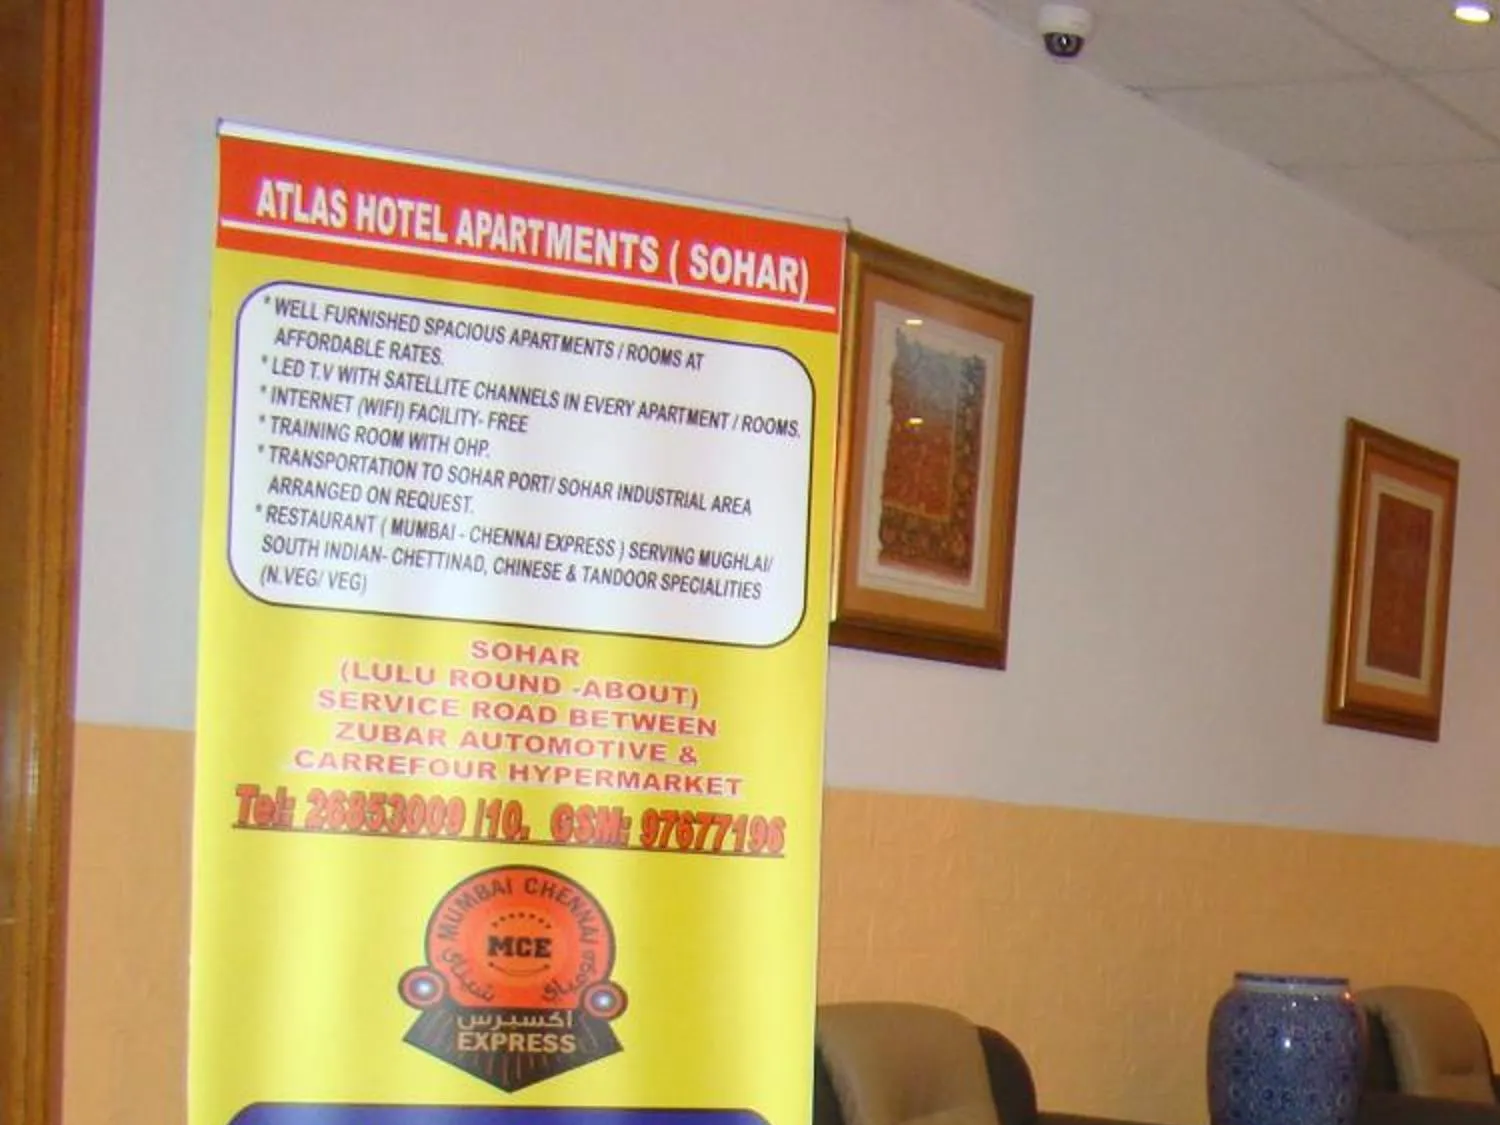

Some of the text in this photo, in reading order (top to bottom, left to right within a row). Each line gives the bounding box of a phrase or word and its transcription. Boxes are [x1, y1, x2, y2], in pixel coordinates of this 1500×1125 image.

[257, 179, 347, 228] ATLAS
[356, 192, 448, 243] HOTEL
[456, 208, 659, 273] APARTMENTS
[274, 296, 319, 321] WELL
[324, 304, 420, 334] FURNISHED
[424, 315, 506, 344] SPACIOUS
[509, 328, 614, 359] APARTMENTS
[626, 343, 682, 368] ROOMS
[686, 354, 705, 371] AT
[274, 328, 445, 365] AFFORDABLE RATES.
[271, 385, 354, 414] INTERNET
[357, 396, 405, 421] (WIFI)
[488, 411, 529, 433] FREE
[272, 356, 305, 379] LED
[310, 361, 335, 382] T.V
[338, 365, 381, 387] WITH
[384, 369, 470, 399] SATELLITE
[474, 380, 559, 409] CHANNELS
[564, 392, 579, 412] IN
[584, 395, 634, 417] EVERY
[637, 402, 730, 431] APARTMENT
[271, 415, 491, 458] TRAINING ROOM WITH OHP.
[267, 476, 475, 514] ARRANGED ON REQUEST.
[269, 445, 417, 481] TRANSPORTATION
[422, 463, 442, 482] TO
[447, 464, 504, 488] SOHAR
[557, 477, 614, 500] SOHAR
[617, 483, 706, 512] INDUSTRIAL
[711, 495, 752, 516] AREA
[265, 504, 377, 534] RESTAURANT
[469, 525, 541, 550] CHENNAI
[629, 541, 694, 567] SERVING
[261, 534, 320, 558] SOUTH
[392, 548, 488, 576] CHETTINAD,
[493, 557, 561, 581] CHINESE
[565, 564, 577, 583] &
[582, 565, 657, 591] TANDOOR
[660, 575, 762, 600] SPECIALITIES
[340, 660, 436, 687] (LULU
[449, 669, 561, 695] ROUND
[471, 640, 580, 667] SOHAR
[318, 689, 717, 737] SERVICE ROAD BETWEEN
[336, 722, 697, 766] ZUBAR AUTOMOTIVE &
[294, 749, 743, 797] CARREFOUR HYPERMARKET
[437, 877, 599, 945] MUMBAI CHENNAI
[487, 935, 552, 958] MCE
[457, 1031, 577, 1053] EXPRESS
